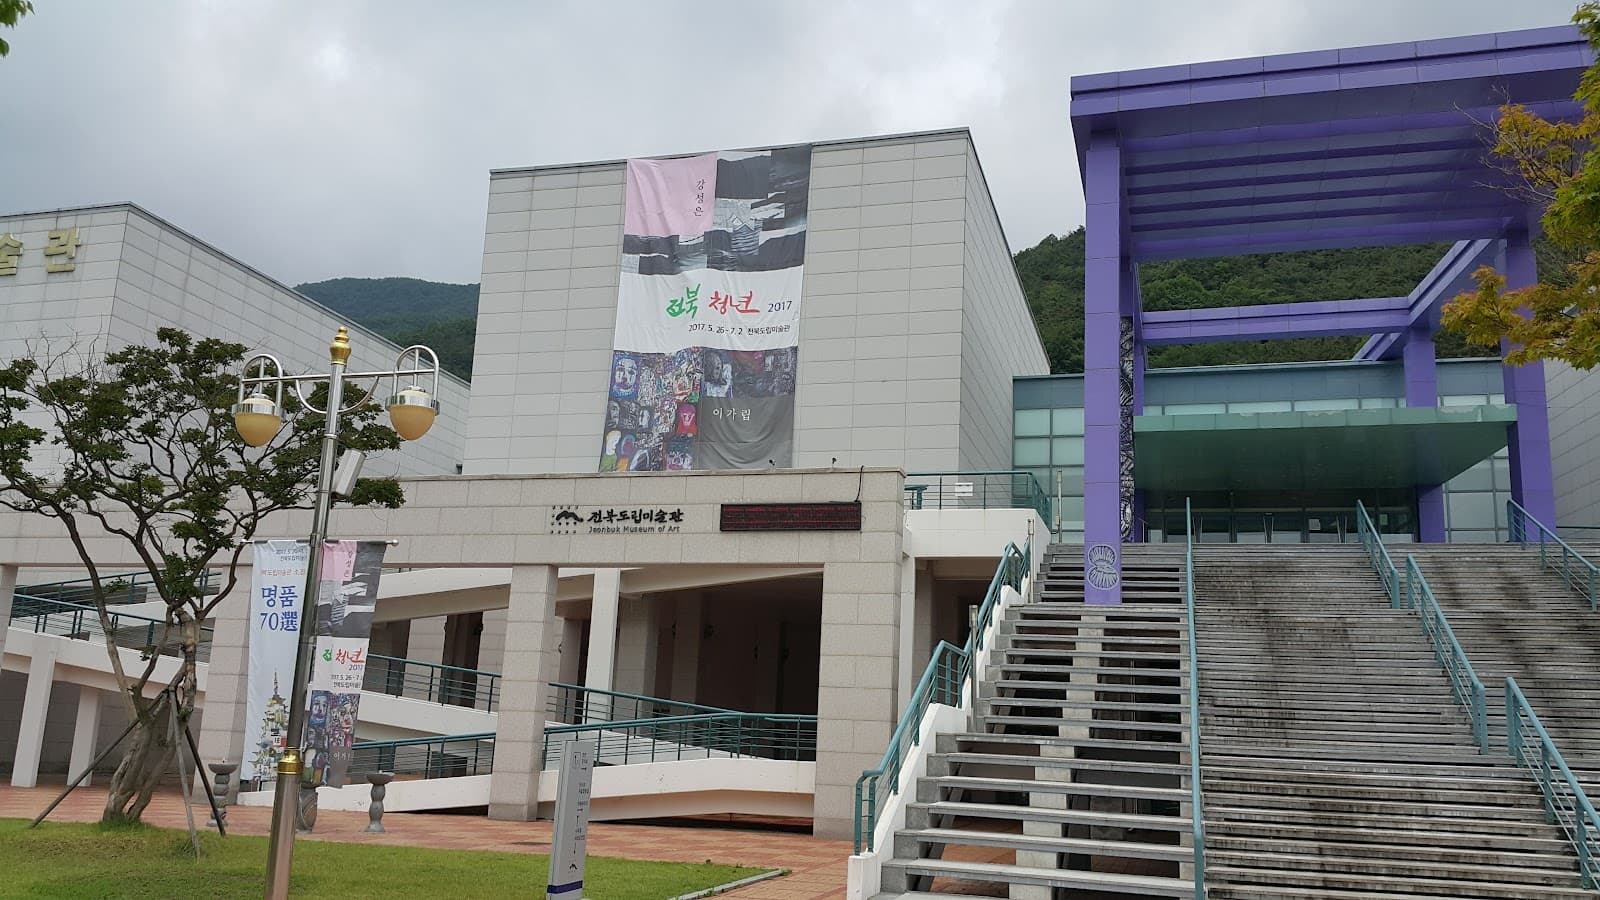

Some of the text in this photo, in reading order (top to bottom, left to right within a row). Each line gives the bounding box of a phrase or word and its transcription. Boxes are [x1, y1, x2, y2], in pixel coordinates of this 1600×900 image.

[693, 179, 707, 216] 강성은
[666, 284, 793, 319] 전북 청년 2017
[587, 508, 684, 523] 전북도립미술관
[588, 526, 621, 534] Jeonbuk
[658, 525, 666, 533] of
[668, 525, 680, 533] Art
[261, 585, 298, 608] 명품
[260, 611, 298, 631] 70選
[335, 647, 365, 664] 청년
